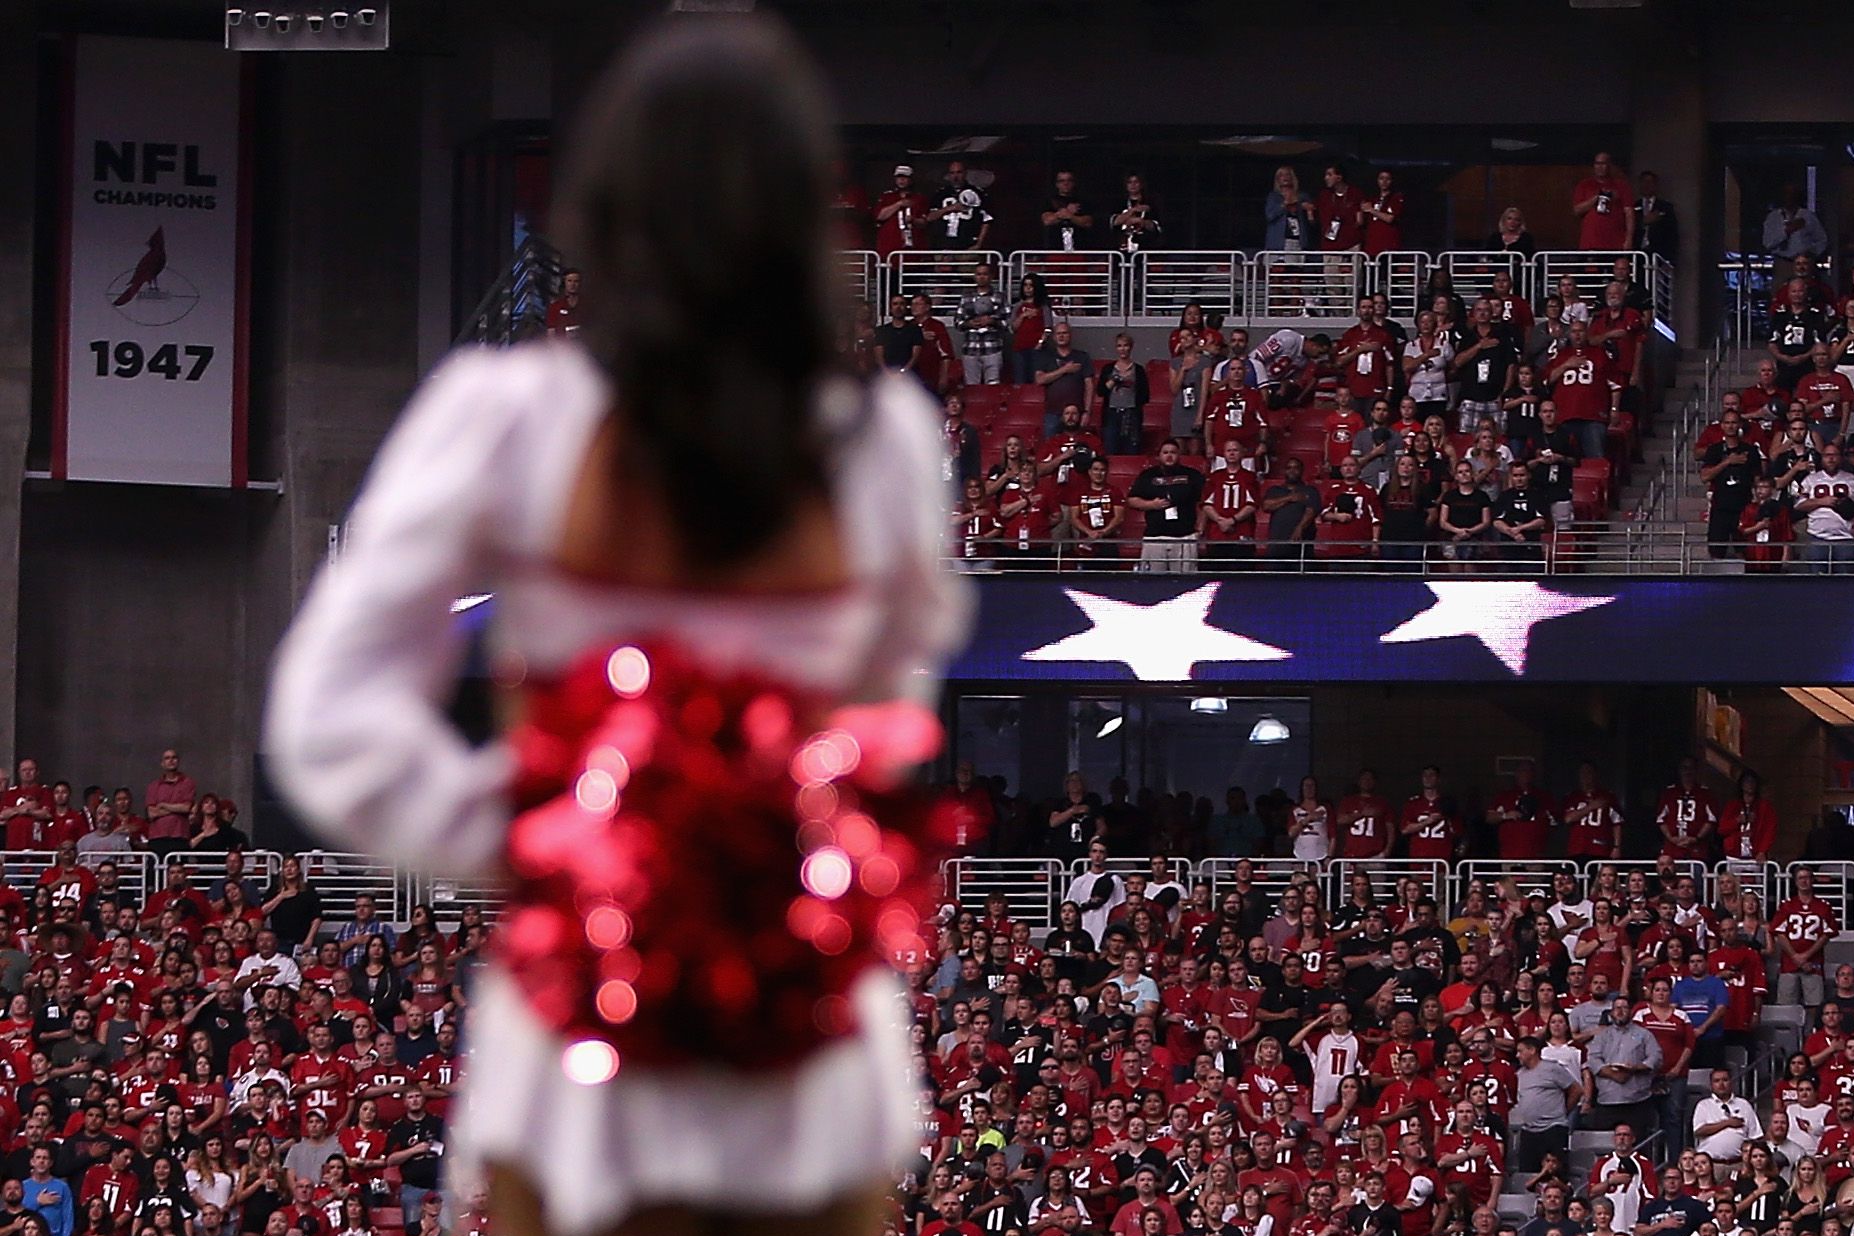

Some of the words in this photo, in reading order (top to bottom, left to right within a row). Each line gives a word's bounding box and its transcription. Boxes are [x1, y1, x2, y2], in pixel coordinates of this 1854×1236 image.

[94, 140, 217, 187] NFL
[93, 188, 217, 211] CHAMPIONS
[90, 340, 214, 381] 1947
[1222, 484, 1239, 509] 11
[1677, 799, 1696, 823] 13
[1788, 914, 1821, 941] 32
[1330, 1047, 1348, 1076] 11
[438, 1067, 451, 1085] 11
[354, 1141, 369, 1159] 7
[103, 1183, 120, 1213] 11
[1748, 1195, 1765, 1221] 11
[987, 1206, 1004, 1231] 11
